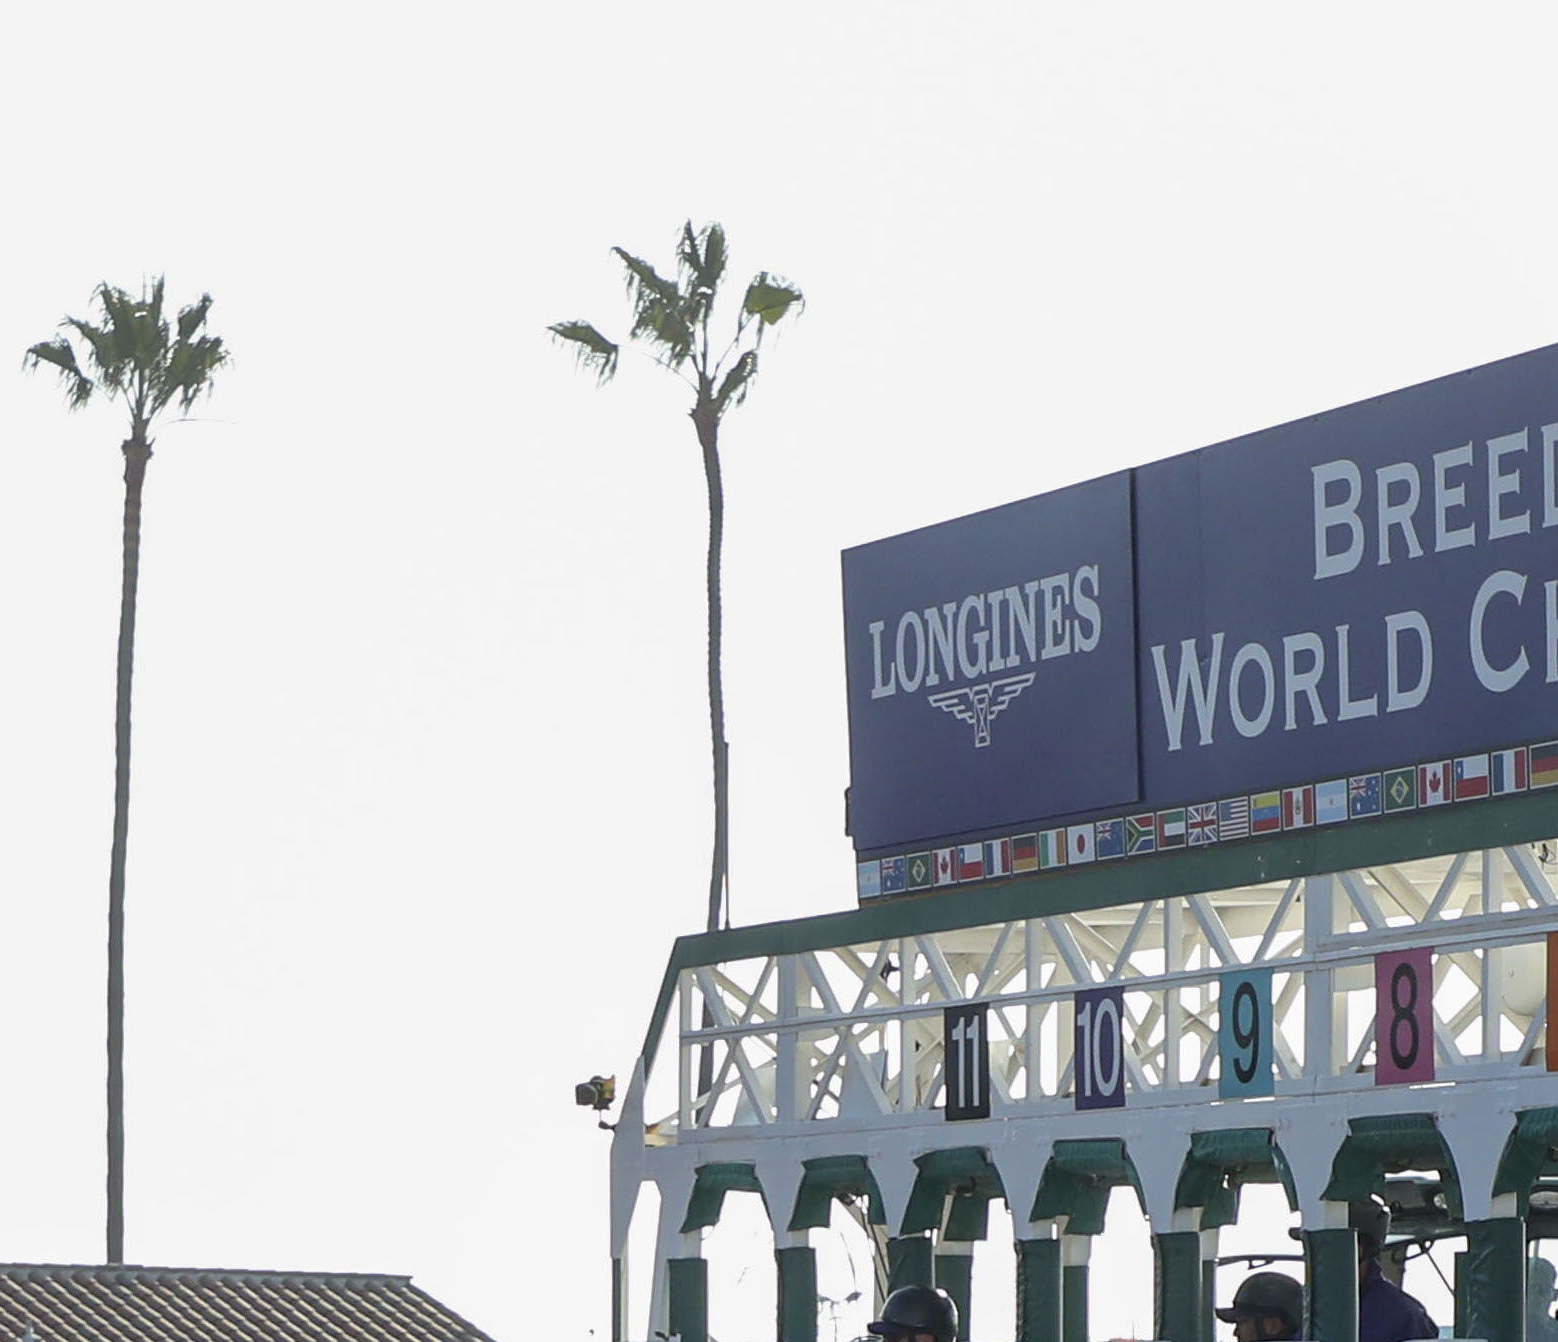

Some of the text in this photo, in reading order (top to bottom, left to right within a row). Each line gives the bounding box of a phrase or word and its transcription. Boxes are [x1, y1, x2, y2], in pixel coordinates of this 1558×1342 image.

[868, 564, 1102, 700] LONGINES
[1150, 610, 1433, 752] WORLD
[952, 1015, 980, 1108] 11
[1077, 998, 1120, 1097] 10
[1232, 981, 1260, 1083] 9
[1390, 961, 1420, 1071] 8
